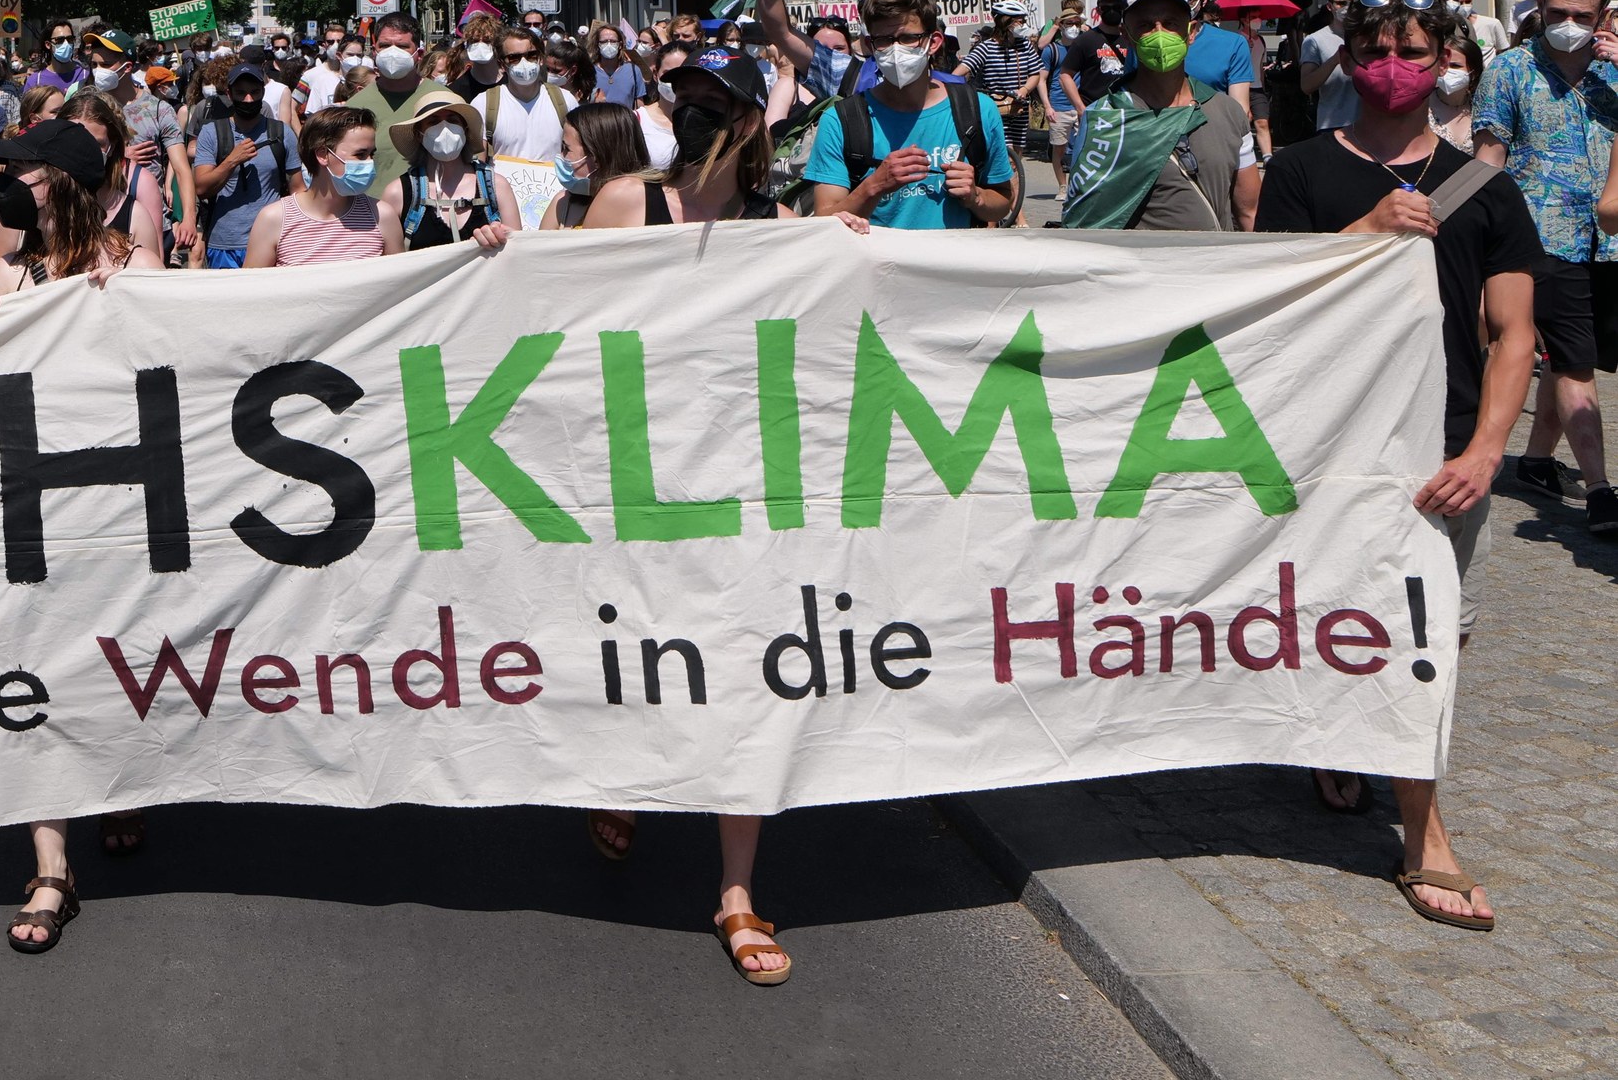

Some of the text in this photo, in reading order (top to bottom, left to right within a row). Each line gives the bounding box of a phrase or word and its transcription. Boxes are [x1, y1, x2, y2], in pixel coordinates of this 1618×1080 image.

[149, 0, 207, 21] STUDENTS
[819, 4, 860, 21] KATA
[151, 17, 174, 31] FOR
[948, 16, 969, 25] RISEUP
[154, 23, 200, 41] FUTURE
[700, 54, 729, 65] NASA
[1067, 117, 1113, 199] 4 FUTUR
[506, 169, 557, 187] REALIT
[515, 183, 556, 200] DOESN'
[95, 605, 544, 721] Wende
[597, 603, 707, 706] in
[762, 584, 933, 701] die
[990, 561, 1438, 684] Hände!
